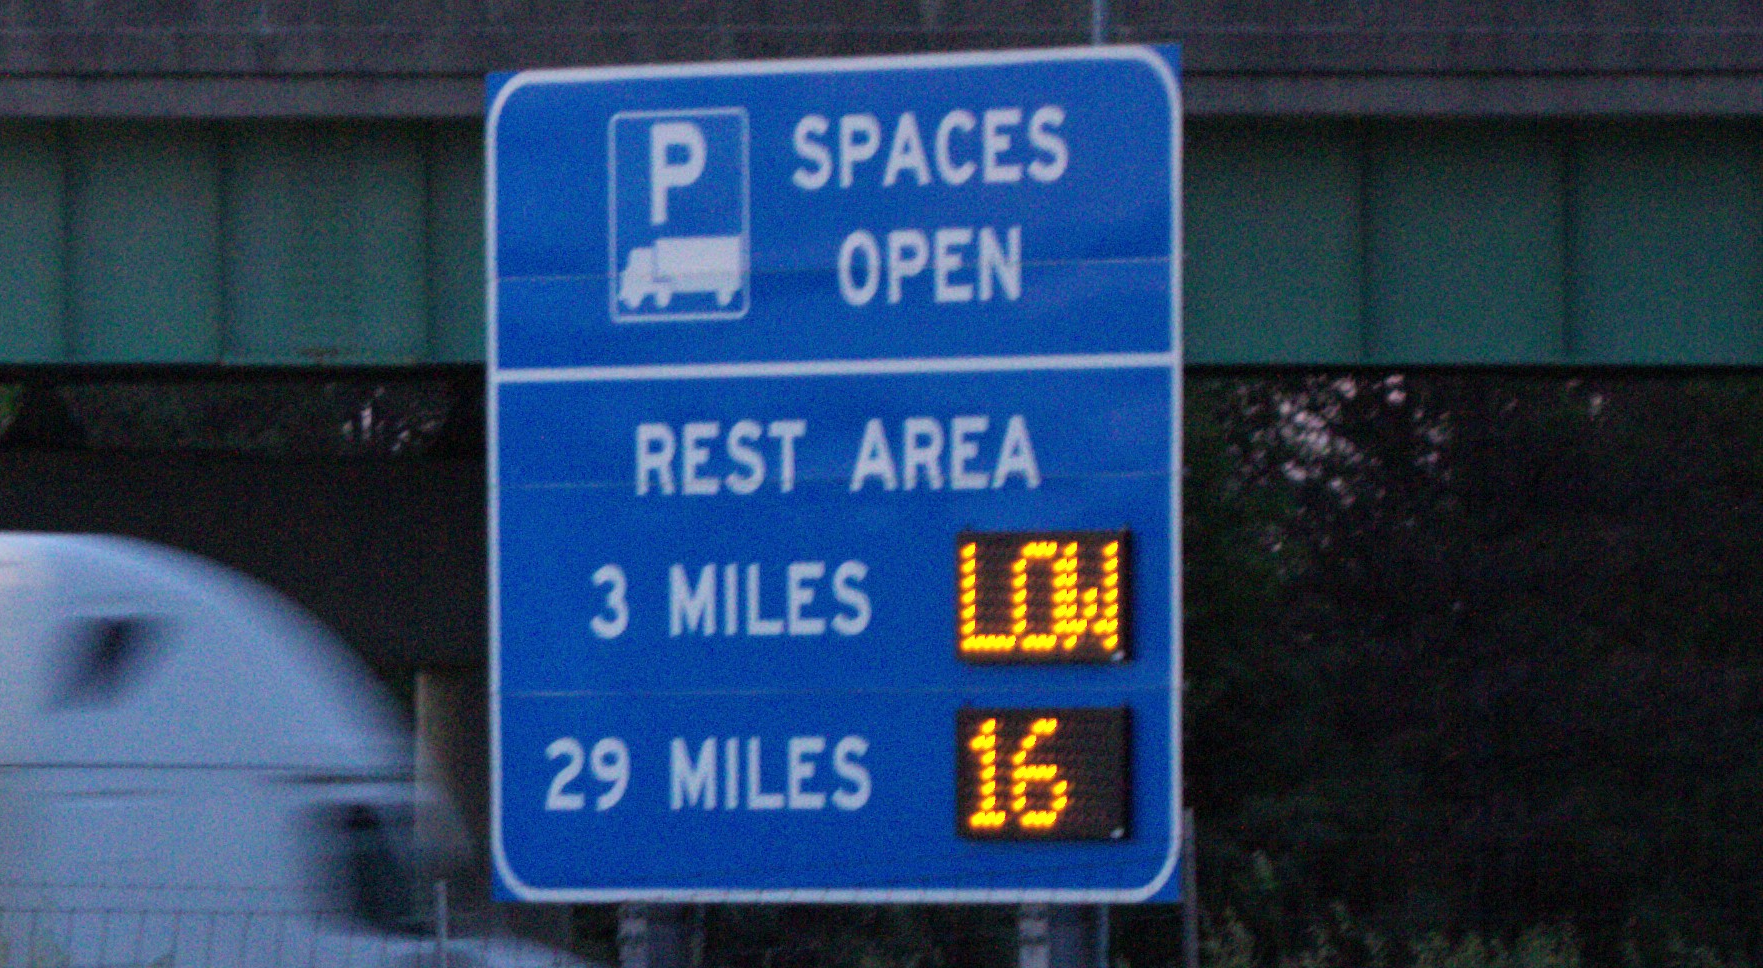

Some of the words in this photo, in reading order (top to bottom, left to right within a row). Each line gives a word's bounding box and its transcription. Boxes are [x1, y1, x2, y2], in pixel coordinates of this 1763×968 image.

[650, 120, 706, 225] P
[793, 105, 1068, 190] SPACES
[838, 227, 1020, 306] OPEN
[636, 420, 804, 495] REST
[851, 415, 1038, 490] AREA
[591, 565, 627, 639] 3
[670, 560, 869, 635] MILES
[959, 541, 1119, 654] LOW
[547, 738, 628, 810] 29
[672, 736, 869, 810] MILES
[968, 718, 1070, 830] 16
